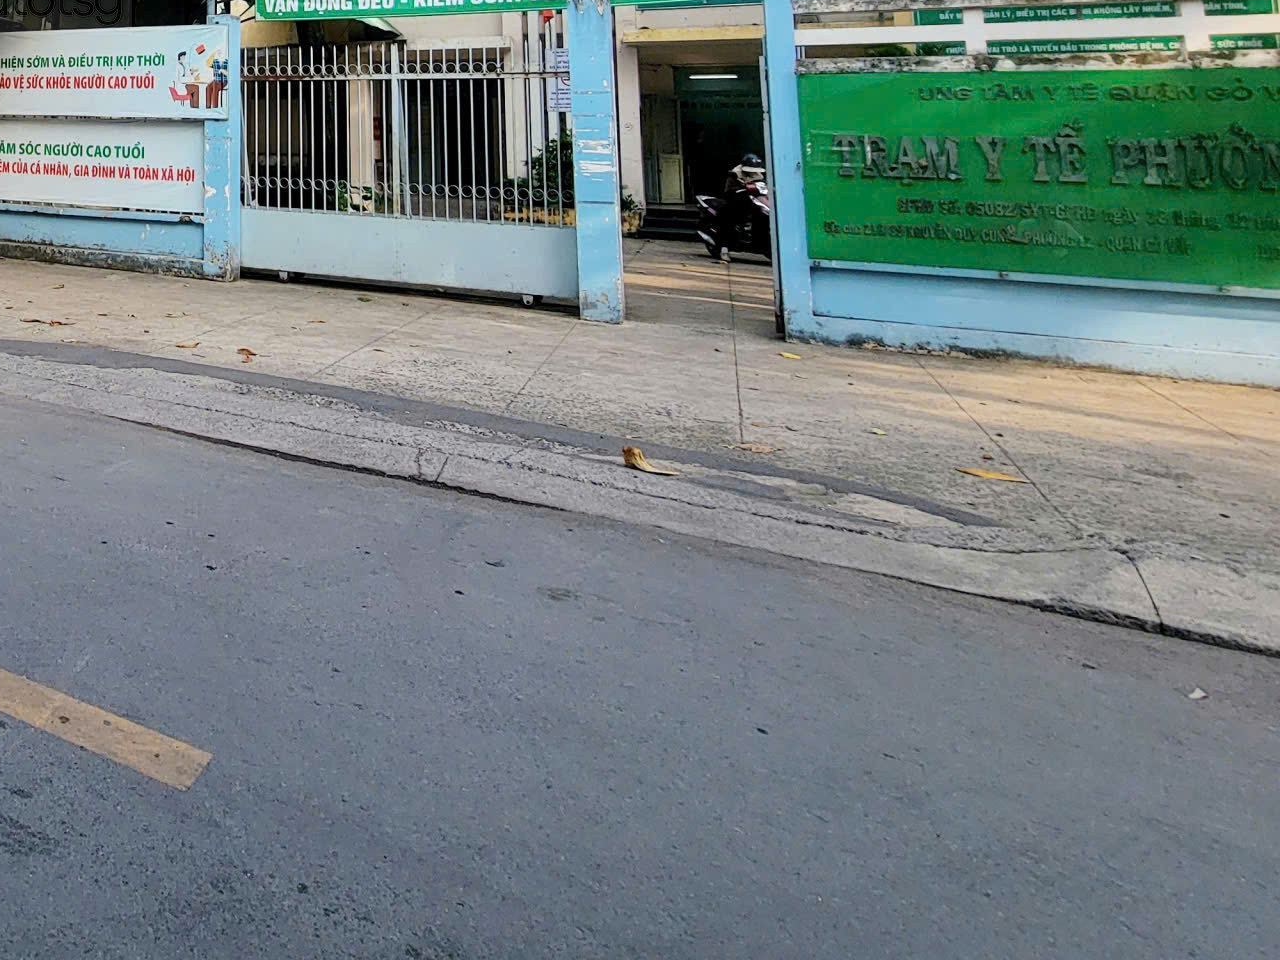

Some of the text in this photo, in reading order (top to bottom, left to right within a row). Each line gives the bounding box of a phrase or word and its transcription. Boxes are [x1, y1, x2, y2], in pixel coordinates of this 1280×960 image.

[1, 55, 24, 72] HIỆN
[27, 54, 50, 68] SỚM
[52, 54, 66, 67] VÀ
[96, 56, 113, 71] TRỊ
[116, 55, 135, 71] KỊP
[137, 52, 165, 66] THỜI
[13, 74, 24, 93] VỆ
[26, 73, 44, 90] SỨC
[46, 72, 71, 89] KHỎE
[73, 72, 105, 89] NGƯỜI
[108, 75, 128, 89] CAO
[130, 70, 155, 89] TUỔI
[19, 140, 41, 155] SÓC
[44, 141, 83, 157] NGƯỜI
[86, 145, 112, 158] CAO
[114, 141, 145, 159] TUỔI
[832, 116, 1280, 191] TRẠM Y TẾ PHƯỜN
[12, 158, 28, 174] CỦA
[30, 159, 41, 175] CÁ
[73, 164, 90, 177] GIA
[92, 162, 116, 178] ĐÌNH
[118, 164, 131, 179] VÀ
[133, 164, 159, 180] TOÀN
[161, 165, 174, 181] XÃ
[177, 166, 195, 186] HỘI
